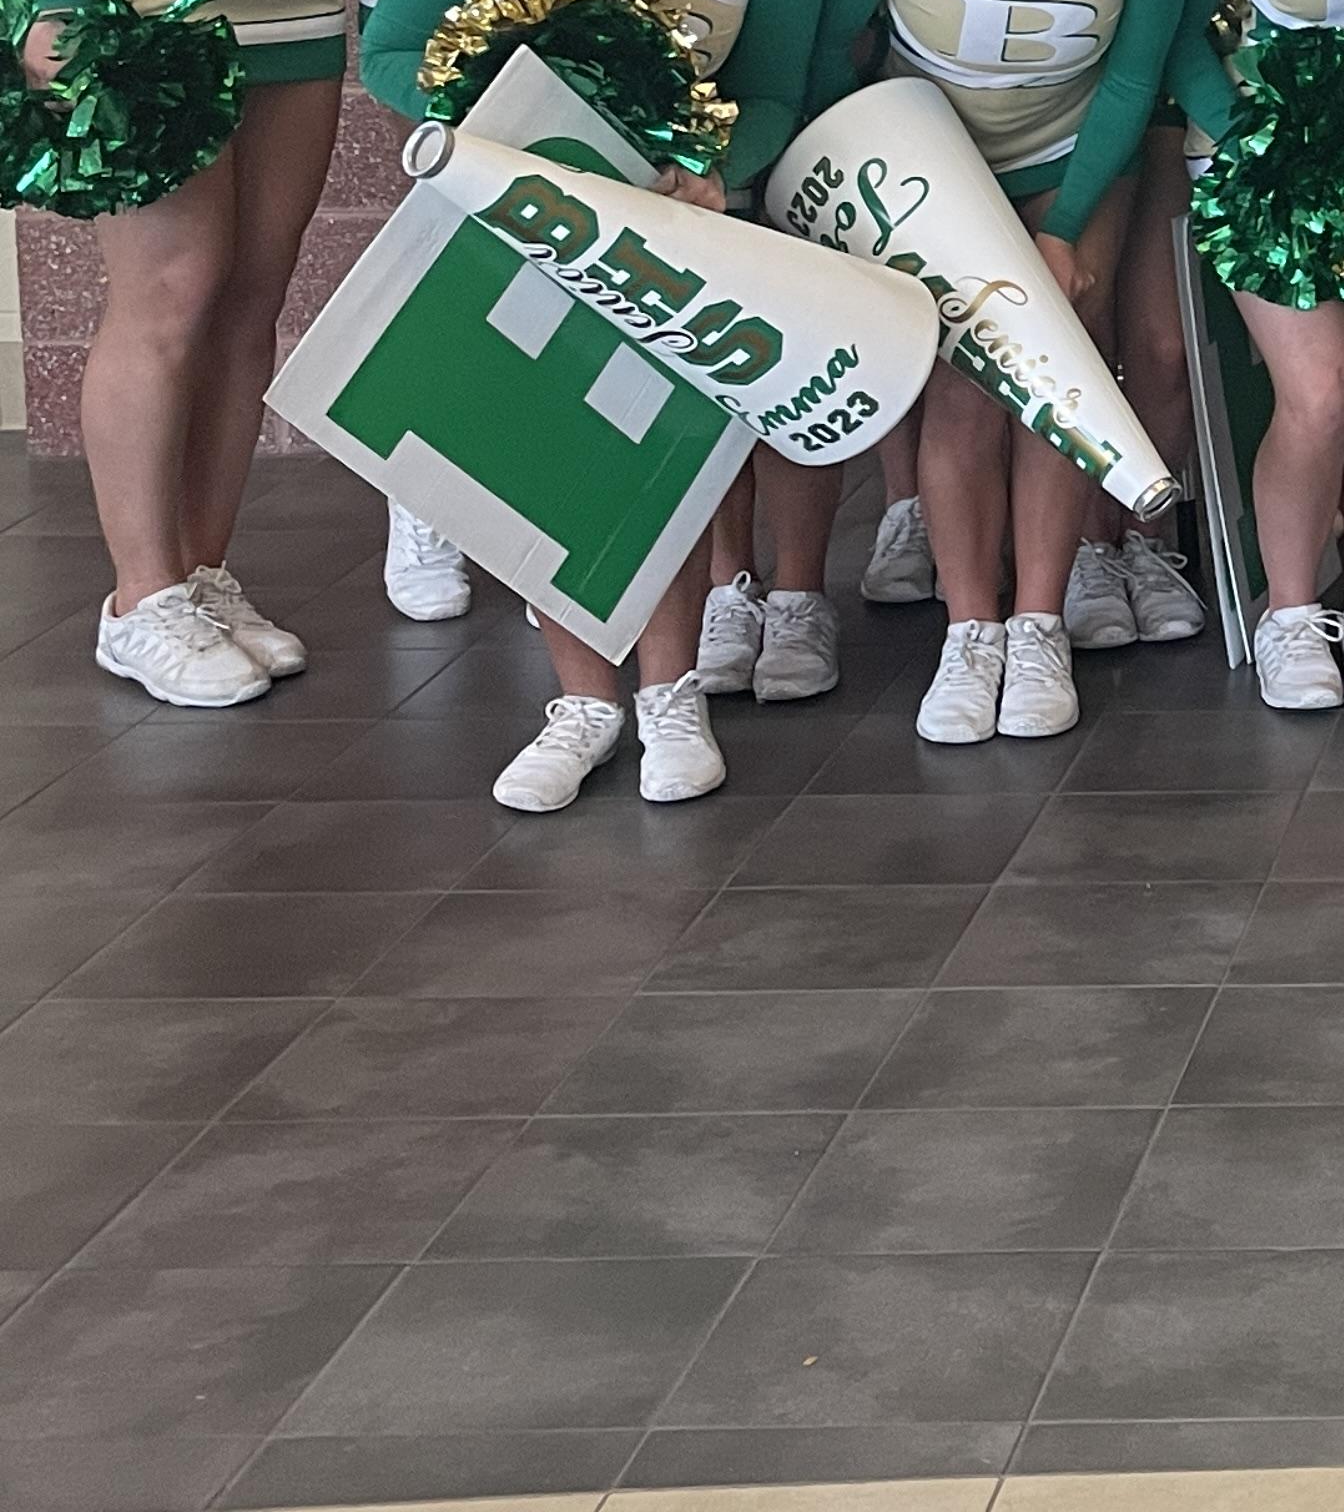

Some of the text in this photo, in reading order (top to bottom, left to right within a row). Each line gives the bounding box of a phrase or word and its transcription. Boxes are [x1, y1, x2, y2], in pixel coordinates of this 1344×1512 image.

[786, 156, 845, 238] 2023
[474, 174, 784, 386] BHS
[714, 343, 861, 436] Emma
[788, 390, 880, 453] 2023
